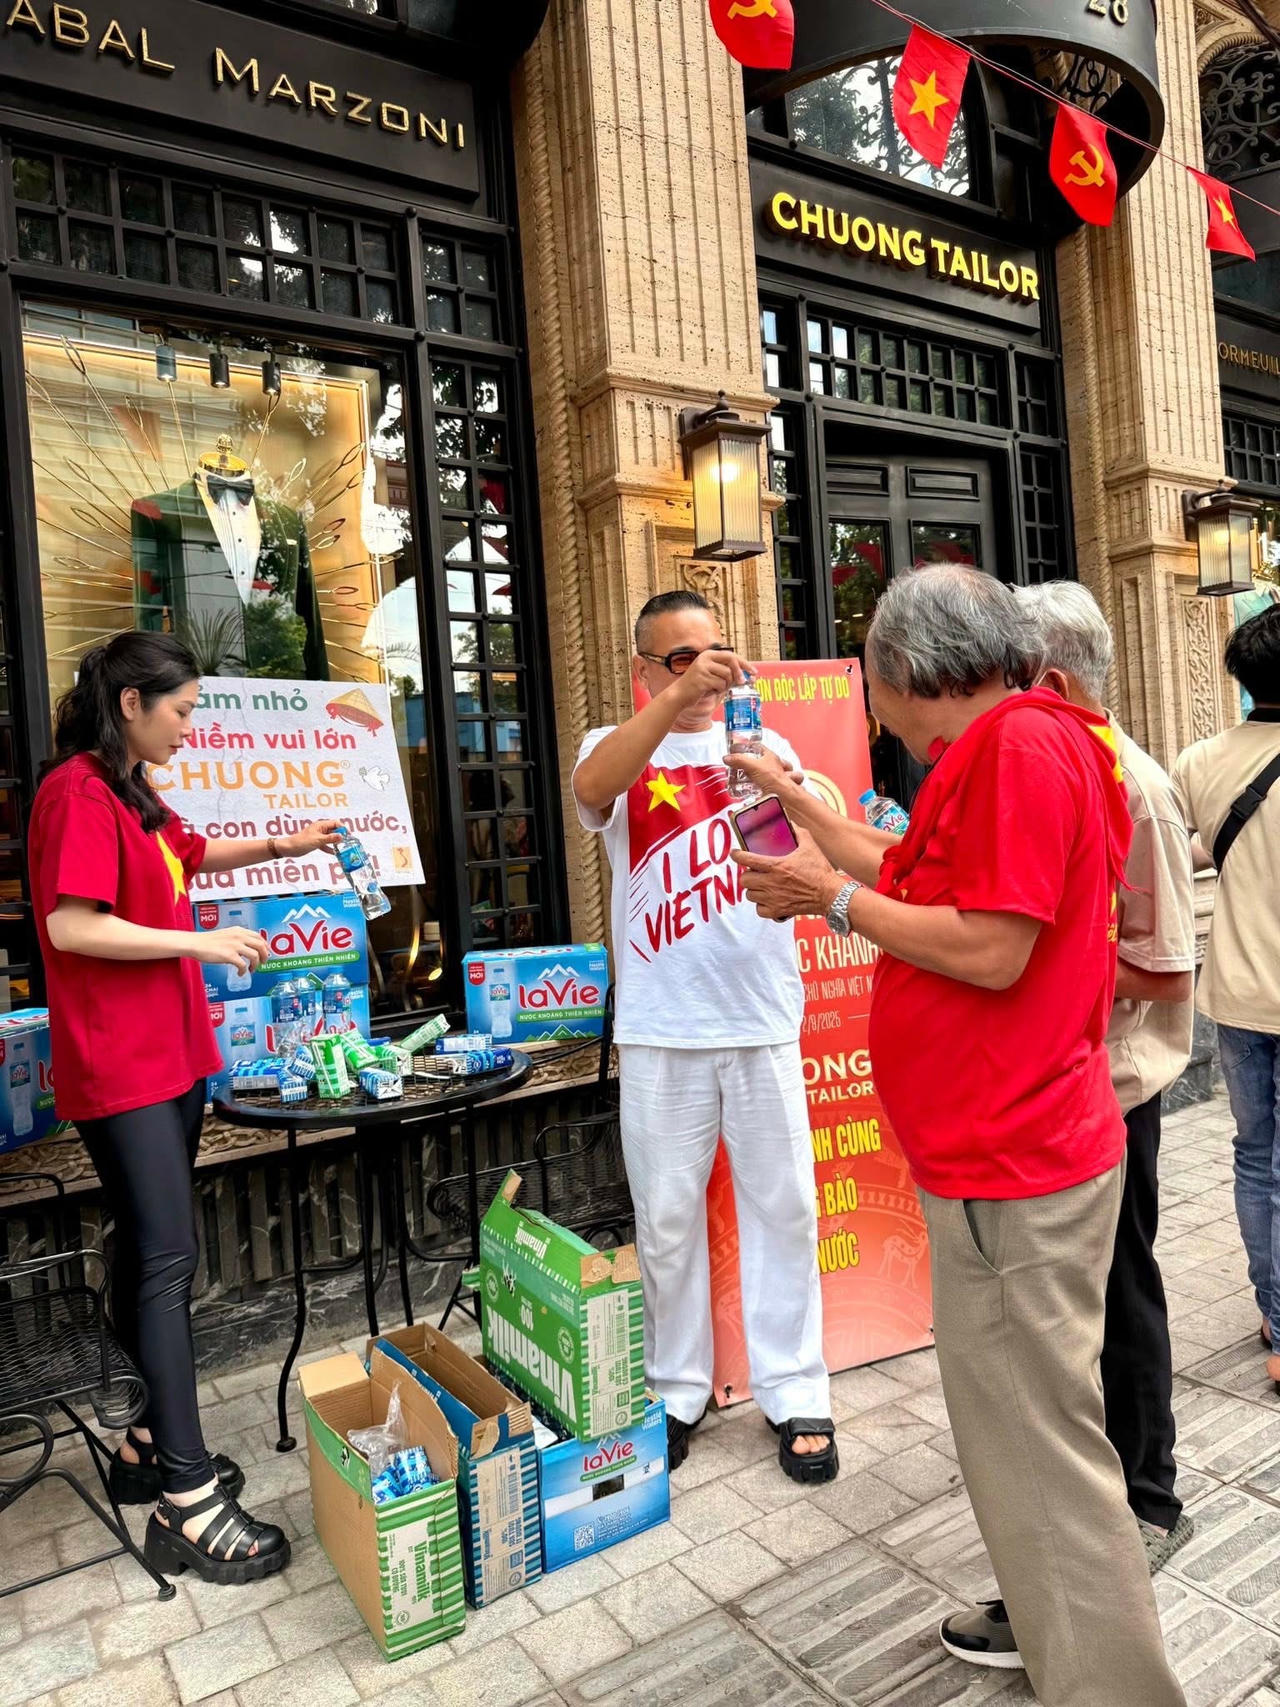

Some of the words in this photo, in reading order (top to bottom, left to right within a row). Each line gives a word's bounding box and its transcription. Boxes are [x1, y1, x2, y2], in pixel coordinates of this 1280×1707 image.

[6, 0, 176, 73] ABAL
[214, 47, 465, 149] MARZONI
[771, 191, 927, 267] CHUONG
[930, 237, 1041, 301] TAILOR
[252, 688, 308, 712] nhỏ
[263, 729, 305, 749] vui
[314, 725, 357, 750] lớn
[263, 792, 349, 809] TAILOR
[205, 820, 257, 839] con
[519, 978, 600, 1009] laVie
[806, 1080, 874, 1105] TAILOR
[836, 1116, 881, 1158] CÙNG
[823, 1173, 858, 1217] BÀO
[487, 1304, 577, 1423] Vinamilk
[584, 1441, 633, 1472] laVie
[414, 1541, 432, 1602] Vinamilk
